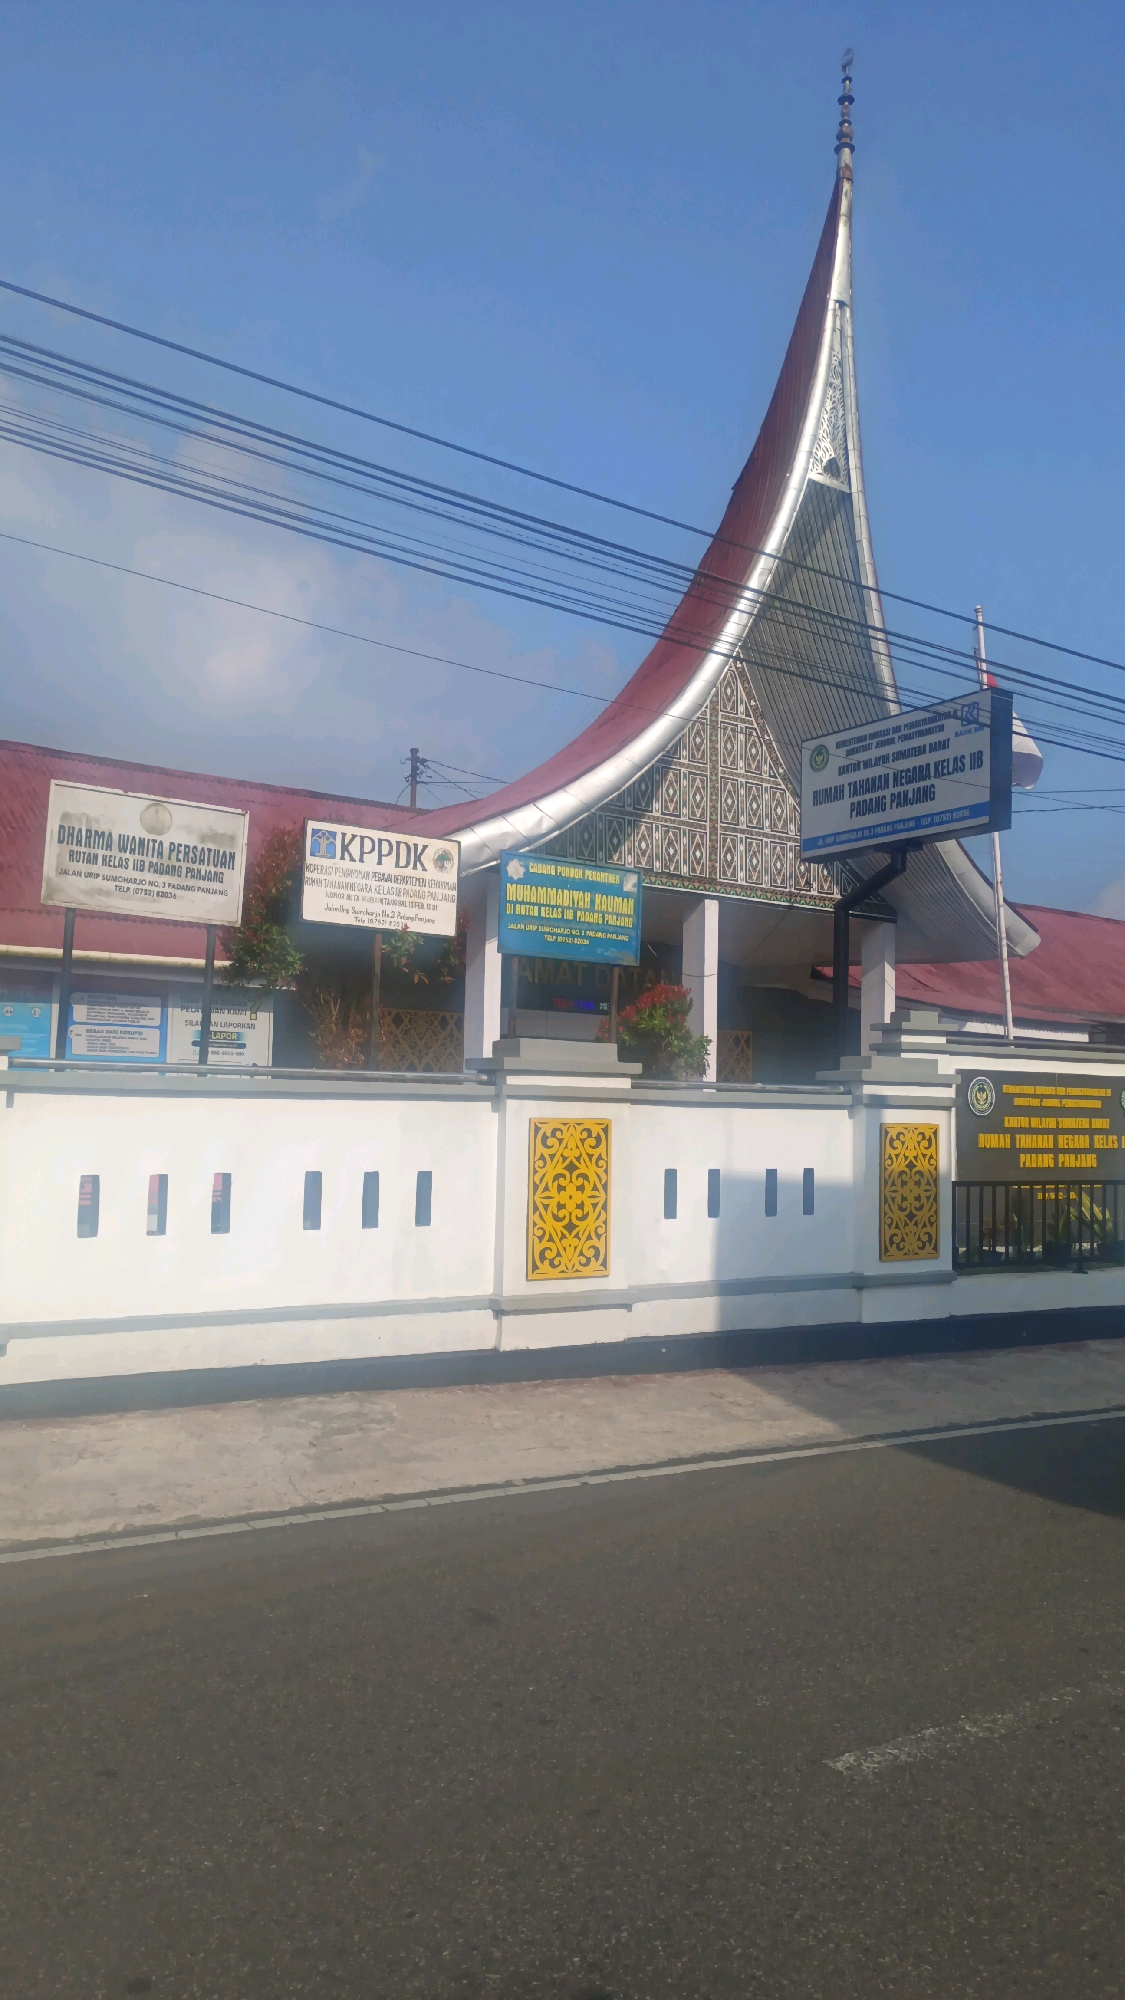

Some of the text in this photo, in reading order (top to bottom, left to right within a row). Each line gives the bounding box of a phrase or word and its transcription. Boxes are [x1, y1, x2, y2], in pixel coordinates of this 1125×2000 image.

[955, 728, 972, 738] BANK
[838, 738, 950, 776] KANTOR WILAYAH SUMATERA BARAT
[812, 750, 983, 807] RUMAH TAHANAN NEGARA KELAS IIB
[850, 783, 936, 819] PADANG PANJANG
[874, 825, 893, 835] PADANG
[57, 824, 236, 870] DHARMA WANITA PERSATUAN
[340, 832, 428, 872] KPPDK
[69, 849, 224, 884] RUTAN KELAS IIB PADANG PANJANG
[306, 863, 333, 876] KOPERASI
[529, 862, 620, 885] CABANG PONDOK PESANTREN
[59, 868, 82, 878] JALAN
[84, 871, 100, 880] URIP
[102, 874, 146, 886] SUMOHARJO
[167, 882, 196, 893] PADANG
[197, 886, 228, 897] PANJANG
[132, 888, 154, 898] (0752)
[156, 891, 177, 900] 82036
[323, 879, 349, 891] TAHANAN
[349, 882, 372, 894] NEGARA
[374, 885, 395, 896] KELAS
[403, 888, 426, 900] PADANG
[427, 891, 456, 903] PANJANG
[325, 891, 345, 899] NOMOR
[506, 883, 634, 915] MUHAMMADIYAH KAUMAN
[324, 903, 339, 912] Jalan
[506, 903, 633, 928] DI RUTAN KELAS IIB PADANG PANJANG
[538, 926, 570, 935] SUMOHARJO
[586, 930, 606, 939] PADANG
[607, 933, 629, 941] PANJANG
[517, 957, 588, 987] AMAT
[220, 1022, 255, 1030] LAPORKAN
[978, 1133, 1011, 1149] RUMAH
[1015, 1134, 1054, 1149] TAHANAN
[1057, 1134, 1090, 1149] NEGARA
[1093, 1134, 1118, 1149] KELAS
[1019, 1153, 1097, 1168] PADANG PANJANG
